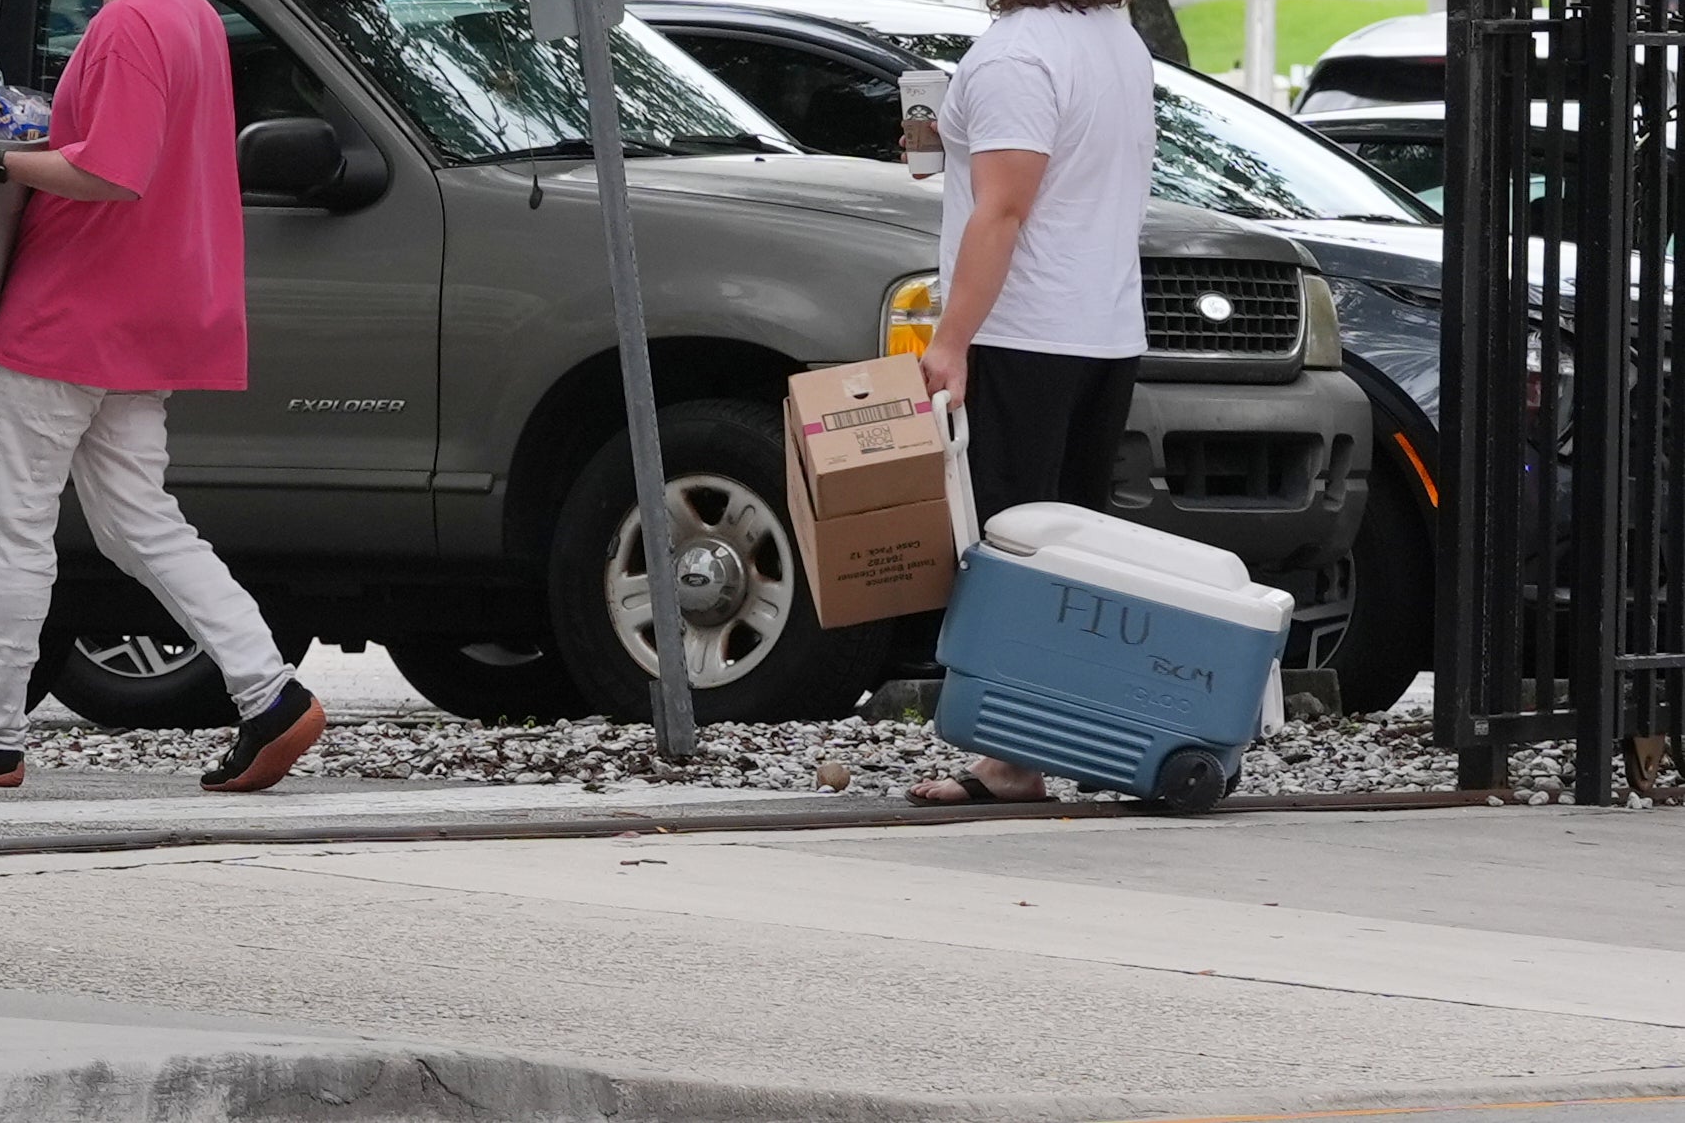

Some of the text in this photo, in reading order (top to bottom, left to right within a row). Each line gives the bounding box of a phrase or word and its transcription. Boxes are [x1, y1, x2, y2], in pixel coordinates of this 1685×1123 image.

[287, 398, 406, 413] EXPLORER
[896, 540, 921, 550] Case
[837, 570, 876, 581] Cleaner
[1051, 582, 1150, 644] FIU
